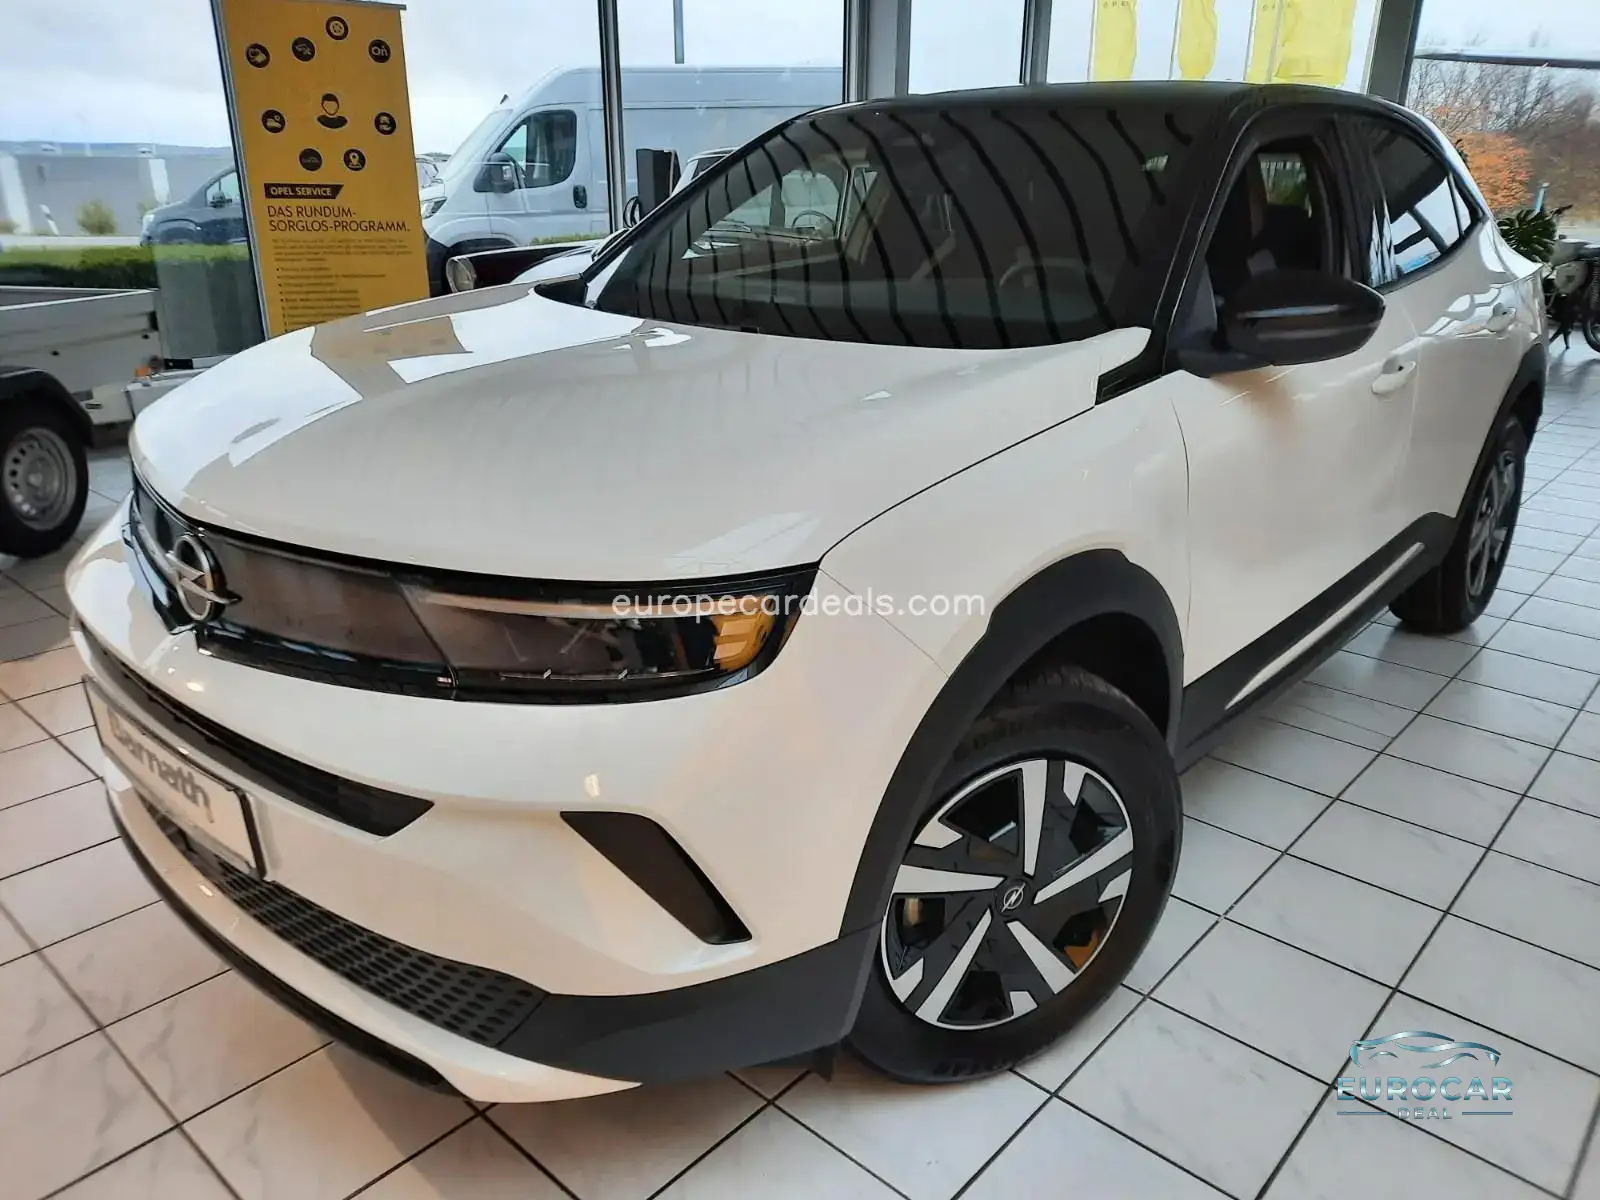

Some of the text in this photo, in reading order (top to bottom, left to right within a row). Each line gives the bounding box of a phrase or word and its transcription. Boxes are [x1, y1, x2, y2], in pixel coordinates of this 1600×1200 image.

[270, 186, 332, 196] OPEL SERVICE
[267, 205, 357, 218] DAS RUNDUM-
[269, 220, 411, 232] SORGLOS-PROGRAMM.
